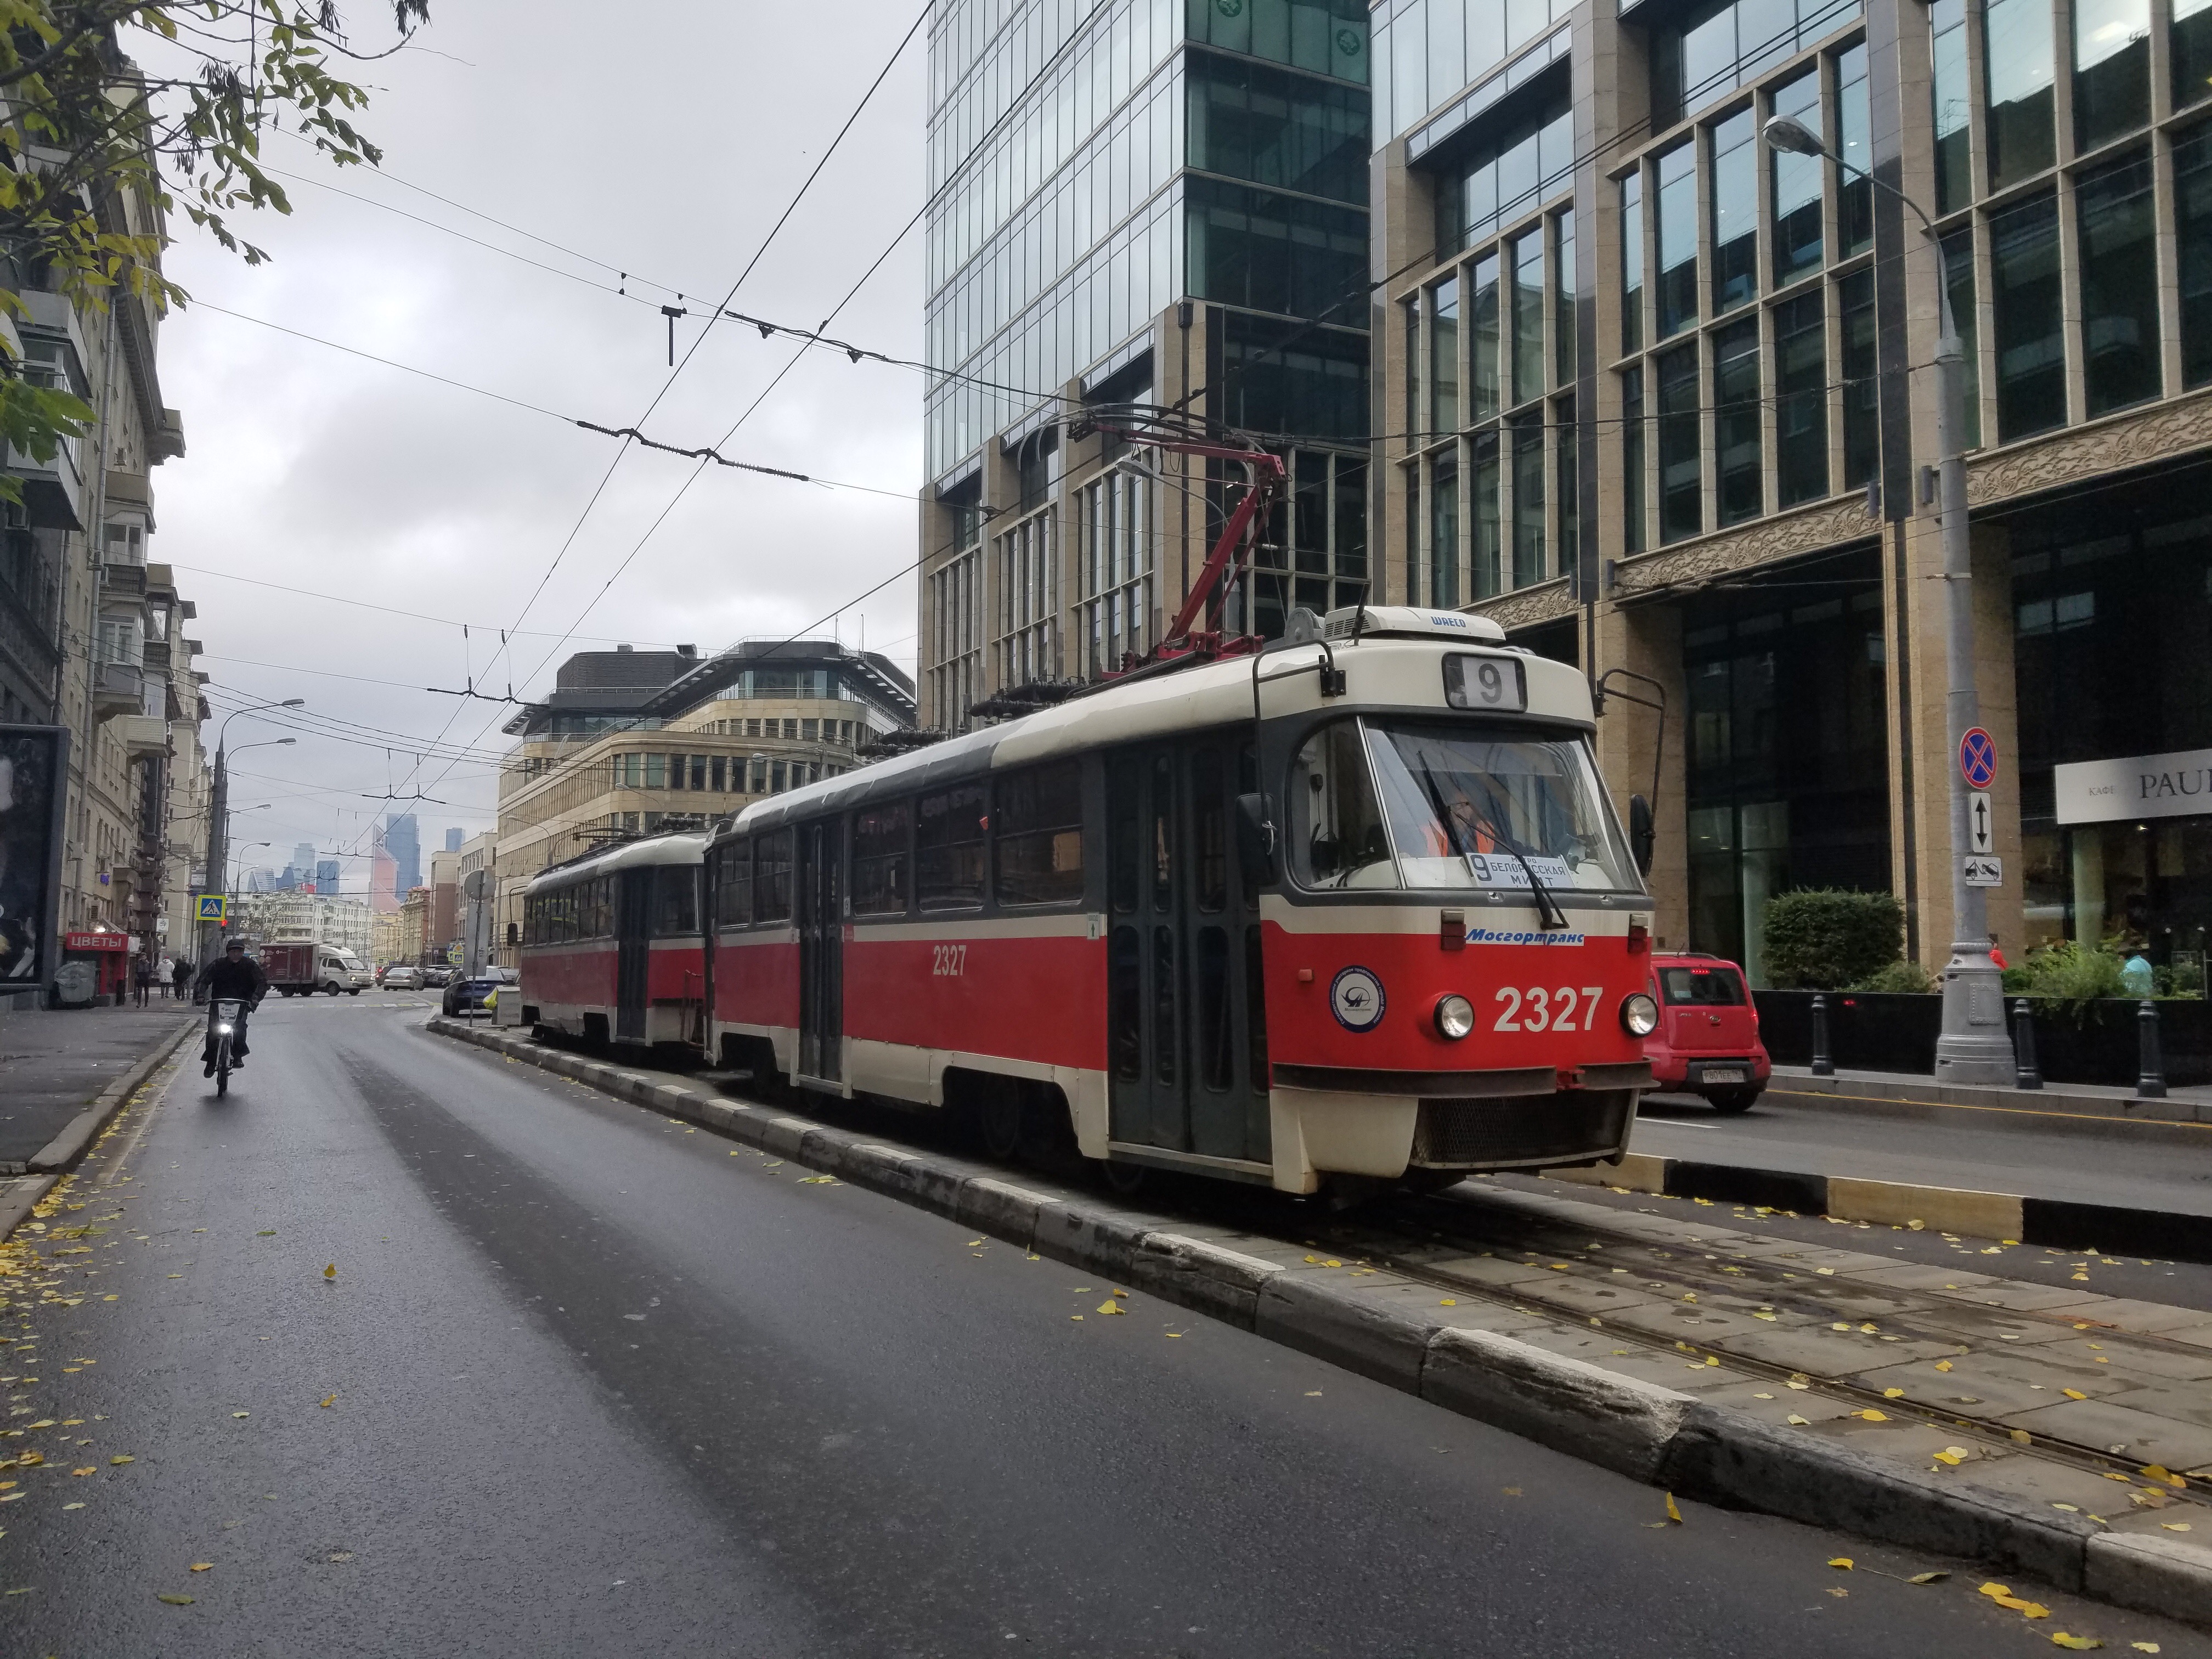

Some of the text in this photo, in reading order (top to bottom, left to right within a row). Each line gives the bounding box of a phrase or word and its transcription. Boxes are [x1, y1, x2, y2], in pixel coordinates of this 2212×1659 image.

[1430, 616, 1466, 628] WAECO
[1479, 663, 1502, 704] 9
[1470, 854, 1492, 882] 9
[71, 936, 121, 947] ЦВЕТЫ
[1466, 929, 1584, 946] Мосгортранс
[933, 945, 967, 976] 2327
[1493, 987, 1603, 1032] 2327
